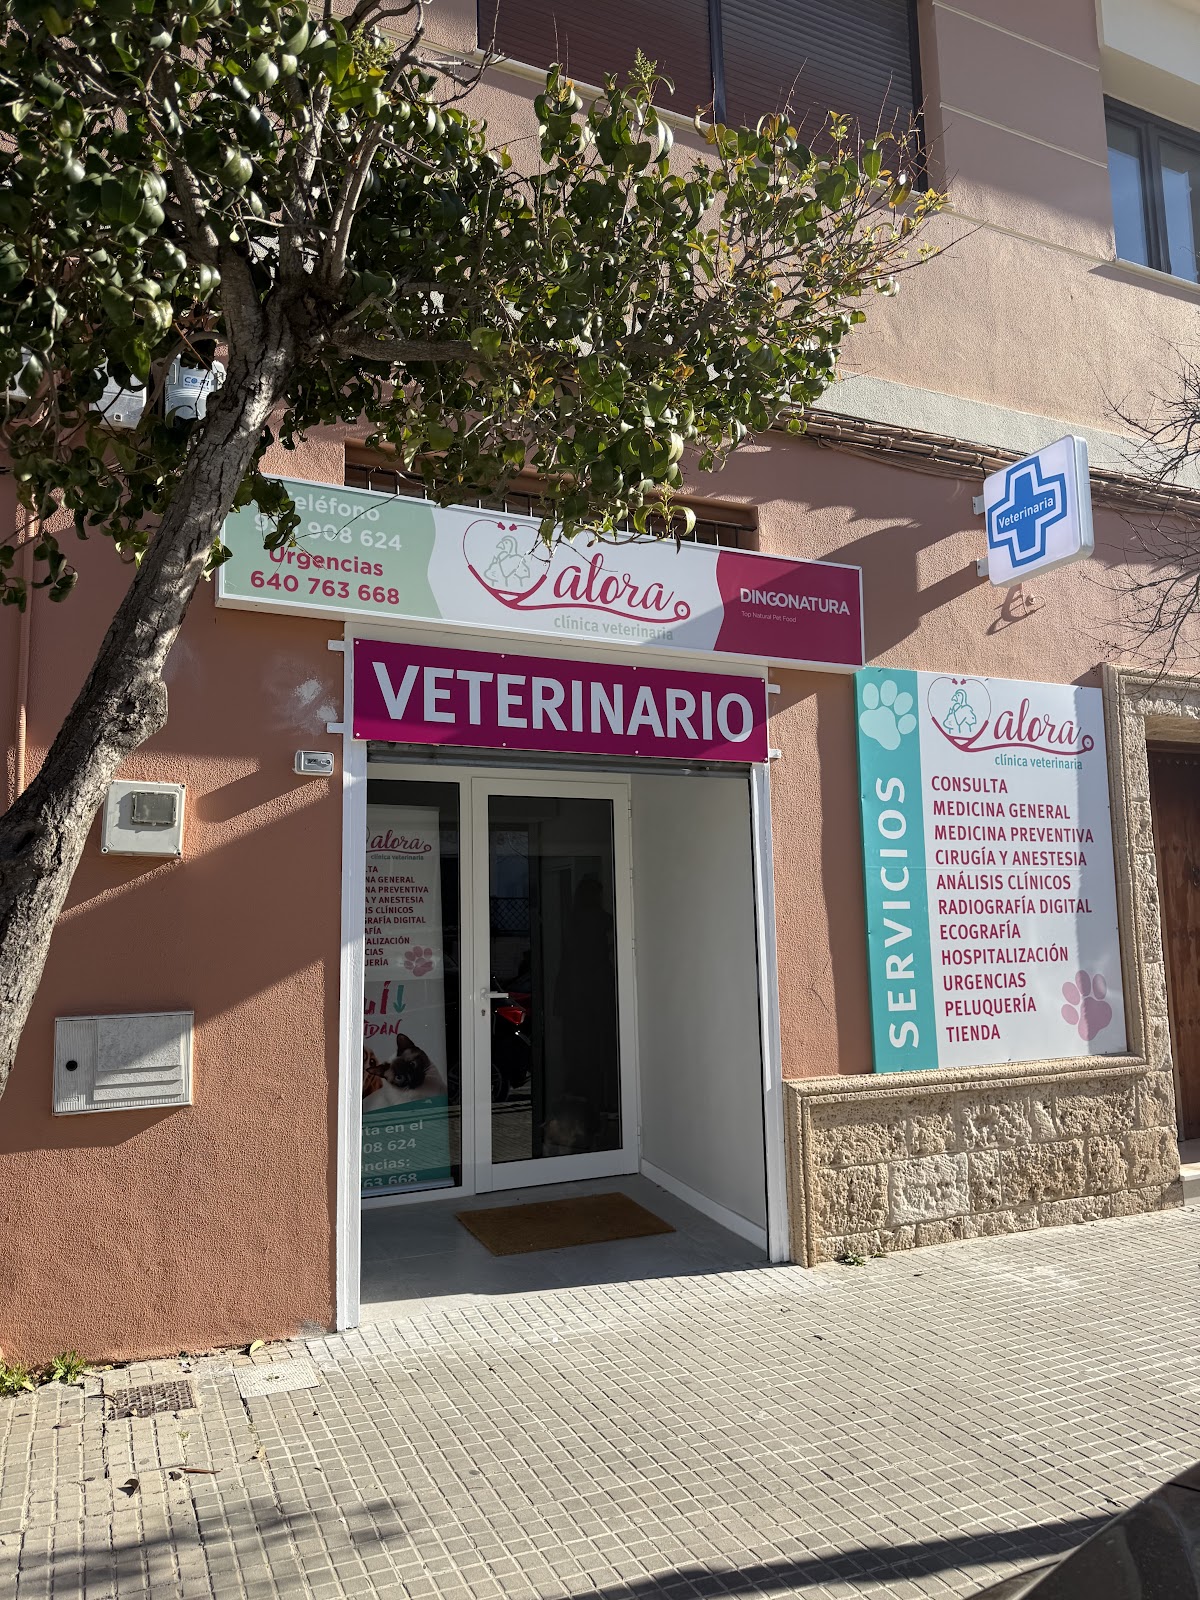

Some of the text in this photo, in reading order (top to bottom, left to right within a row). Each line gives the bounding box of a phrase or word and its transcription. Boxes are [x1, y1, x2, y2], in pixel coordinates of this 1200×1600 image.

[287, 491, 380, 522] eléfono
[998, 497, 1054, 528] Veterinaria
[307, 522, 353, 544] 908
[360, 530, 402, 551] 624
[269, 546, 384, 577] Urgencias
[251, 571, 400, 605] 640 763 668
[553, 553, 675, 612] alora
[740, 588, 851, 616] DINGONATURA
[753, 612, 772, 620] Natural
[783, 615, 797, 623] Food
[554, 615, 674, 641] clínica veterinaria
[372, 661, 754, 743] VETERINARIO
[993, 698, 1082, 745] alora
[995, 754, 1083, 770] clínica veterinaria
[931, 775, 1008, 794] CONSULTA
[933, 800, 1071, 819] MEDICINA GENERAL
[371, 829, 425, 850] alora
[934, 825, 1094, 843] MEDICINA PREVENTIVA
[935, 847, 1087, 866] CIRUGÍA Y ANESTESIA
[377, 876, 415, 884] GENERAL
[936, 871, 1071, 890] ANÁLISIS CLÍNICOS
[375, 905, 414, 914] CLÍNICOS
[378, 896, 424, 904] ANESTESIA
[938, 895, 1092, 915] RADIOGRAFÍA DIGITAL
[393, 916, 426, 924] DIGITAL
[875, 776, 920, 1049] SERVICIOS
[364, 935, 410, 945] ALIZACIÓN
[940, 920, 1021, 940] ECOGRAFÍA
[941, 943, 1069, 966] HOSPITALIZACIÓN
[943, 972, 1027, 991] URGENCIAS
[945, 993, 1037, 1017] PELUQUERÍA
[946, 1023, 1001, 1043] TIENDA
[385, 1124, 405, 1134] en
[409, 1119, 423, 1131] el
[387, 1138, 417, 1151] 624
[388, 1173, 418, 1185] 668
